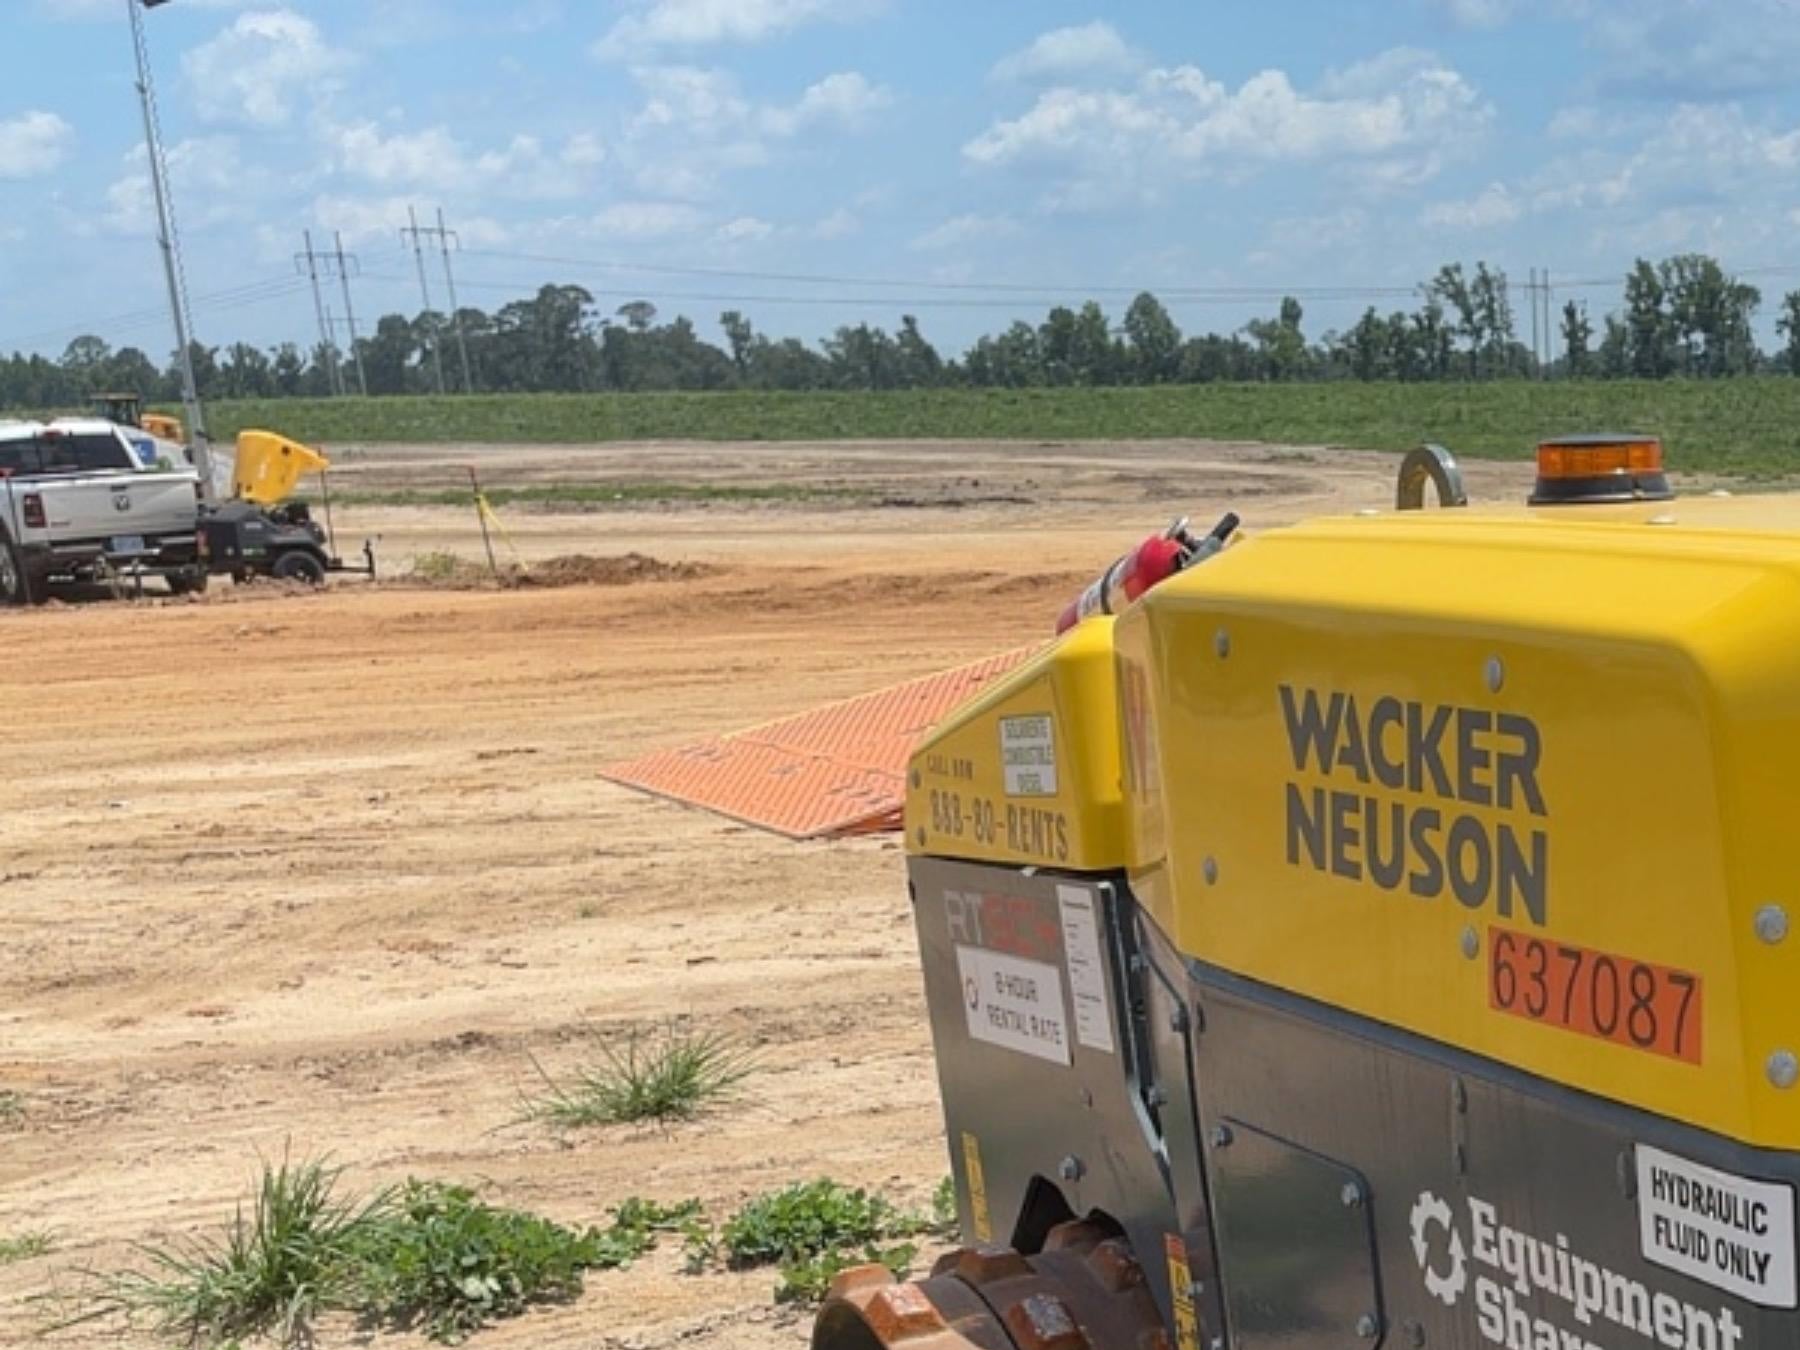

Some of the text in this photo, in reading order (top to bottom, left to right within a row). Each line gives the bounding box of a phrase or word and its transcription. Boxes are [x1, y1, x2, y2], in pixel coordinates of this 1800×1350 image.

[1278, 684, 1548, 817] WACKER
[1286, 782, 1547, 927] NEUSON
[1493, 932, 1696, 1055] 637087
[1651, 1166, 1769, 1236] HYDRAULIC
[1655, 1214, 1772, 1286] FLUID ONLY
